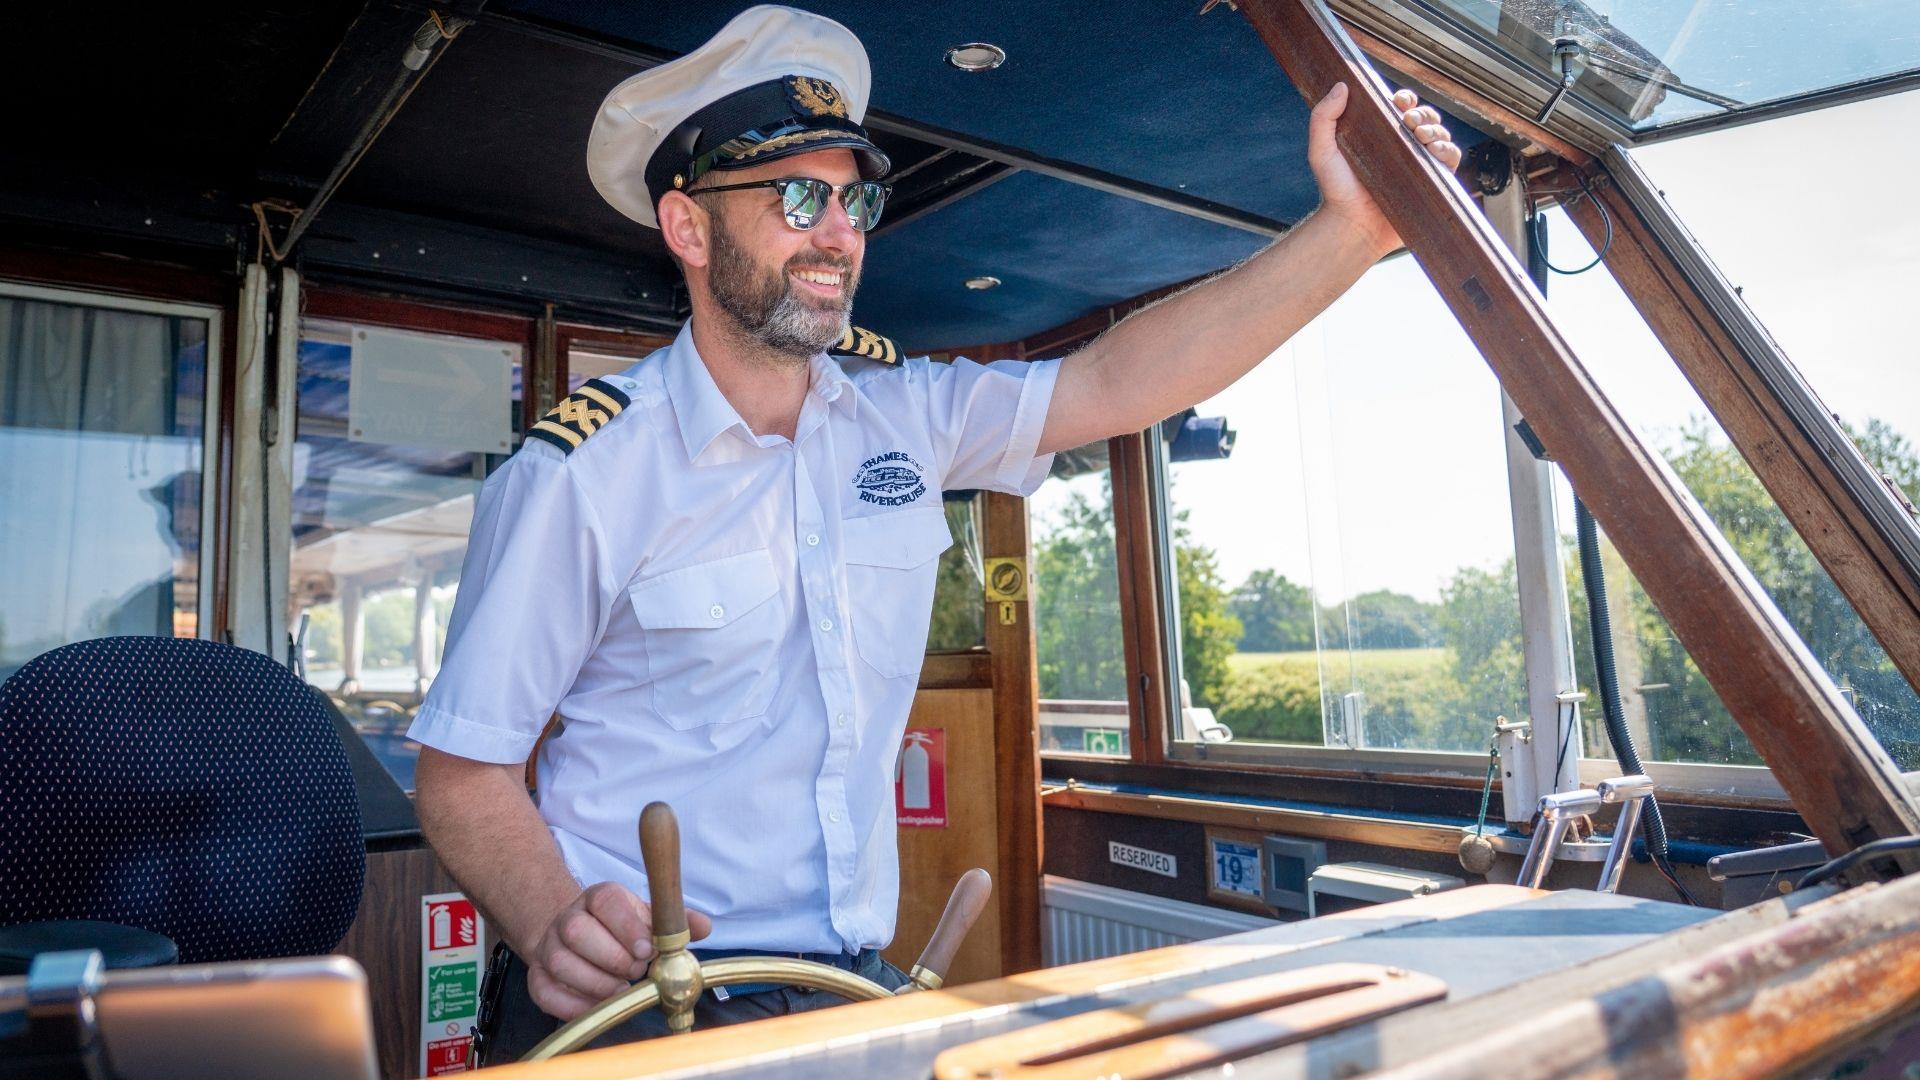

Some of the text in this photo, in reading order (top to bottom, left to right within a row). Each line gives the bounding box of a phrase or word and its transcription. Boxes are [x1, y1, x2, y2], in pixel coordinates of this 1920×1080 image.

[861, 451, 909, 470] THAMES
[859, 482, 926, 507] RIVERCRUISE
[1113, 845, 1170, 872] RESERVED
[1217, 855, 1243, 884] 19
